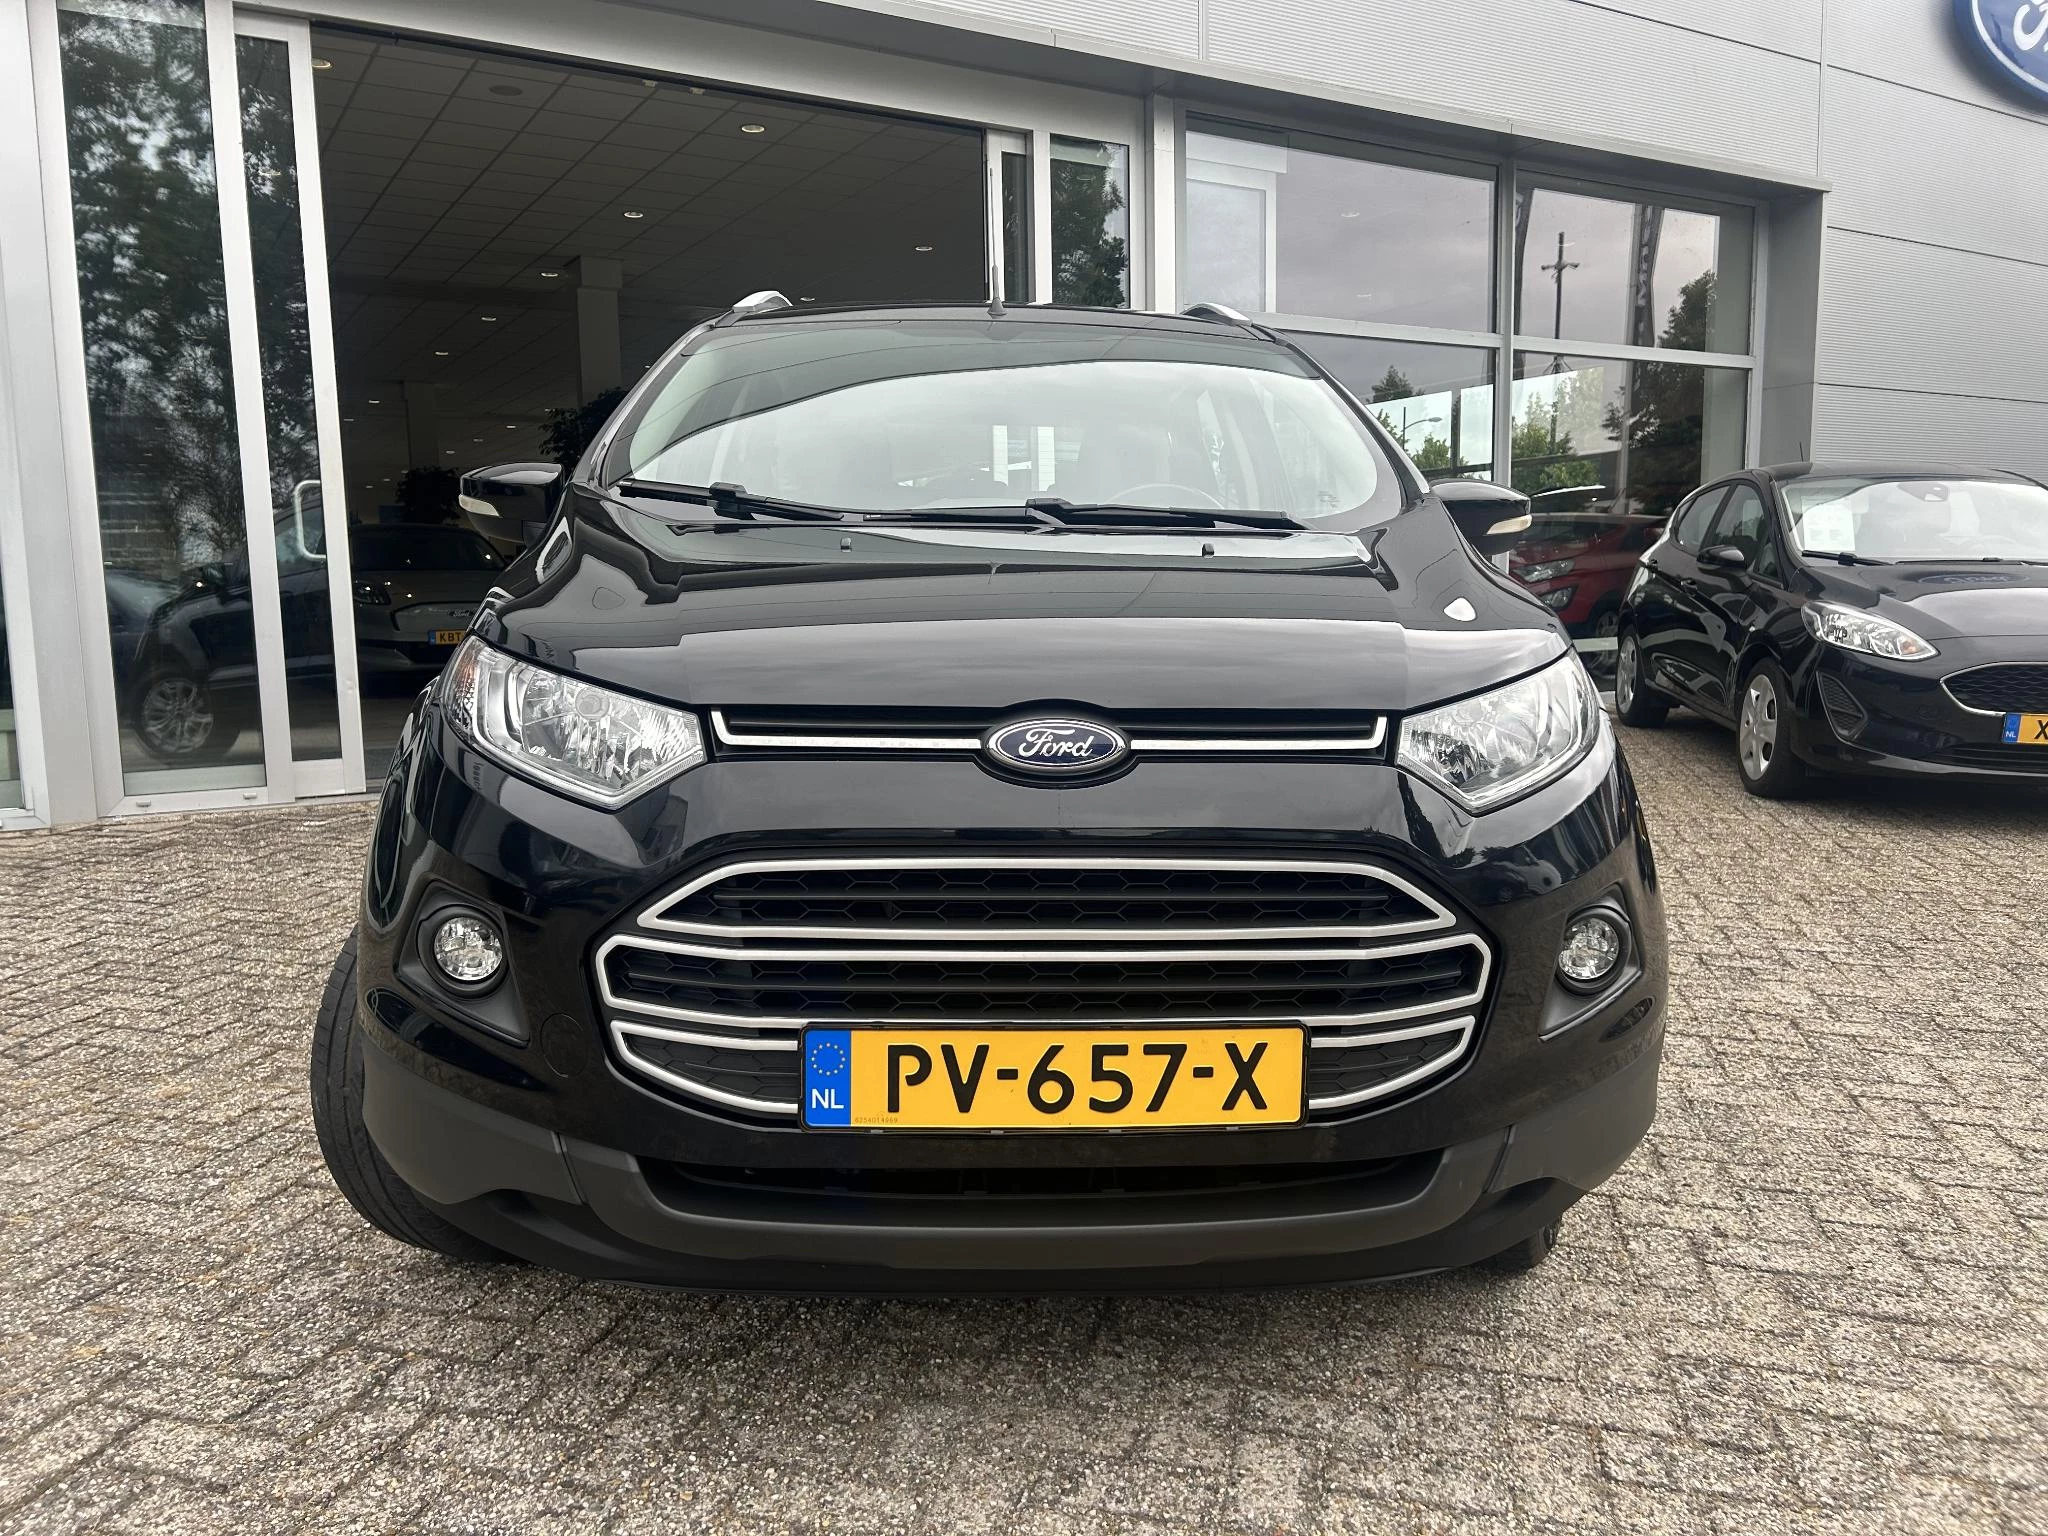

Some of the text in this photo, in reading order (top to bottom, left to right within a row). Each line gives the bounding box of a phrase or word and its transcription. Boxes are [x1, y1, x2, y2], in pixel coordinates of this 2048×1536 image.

[1018, 728, 1095, 757] Ford
[2005, 730, 2017, 738] NL
[887, 1042, 1269, 1114] PV-657-X
[811, 1088, 845, 1109] NL
